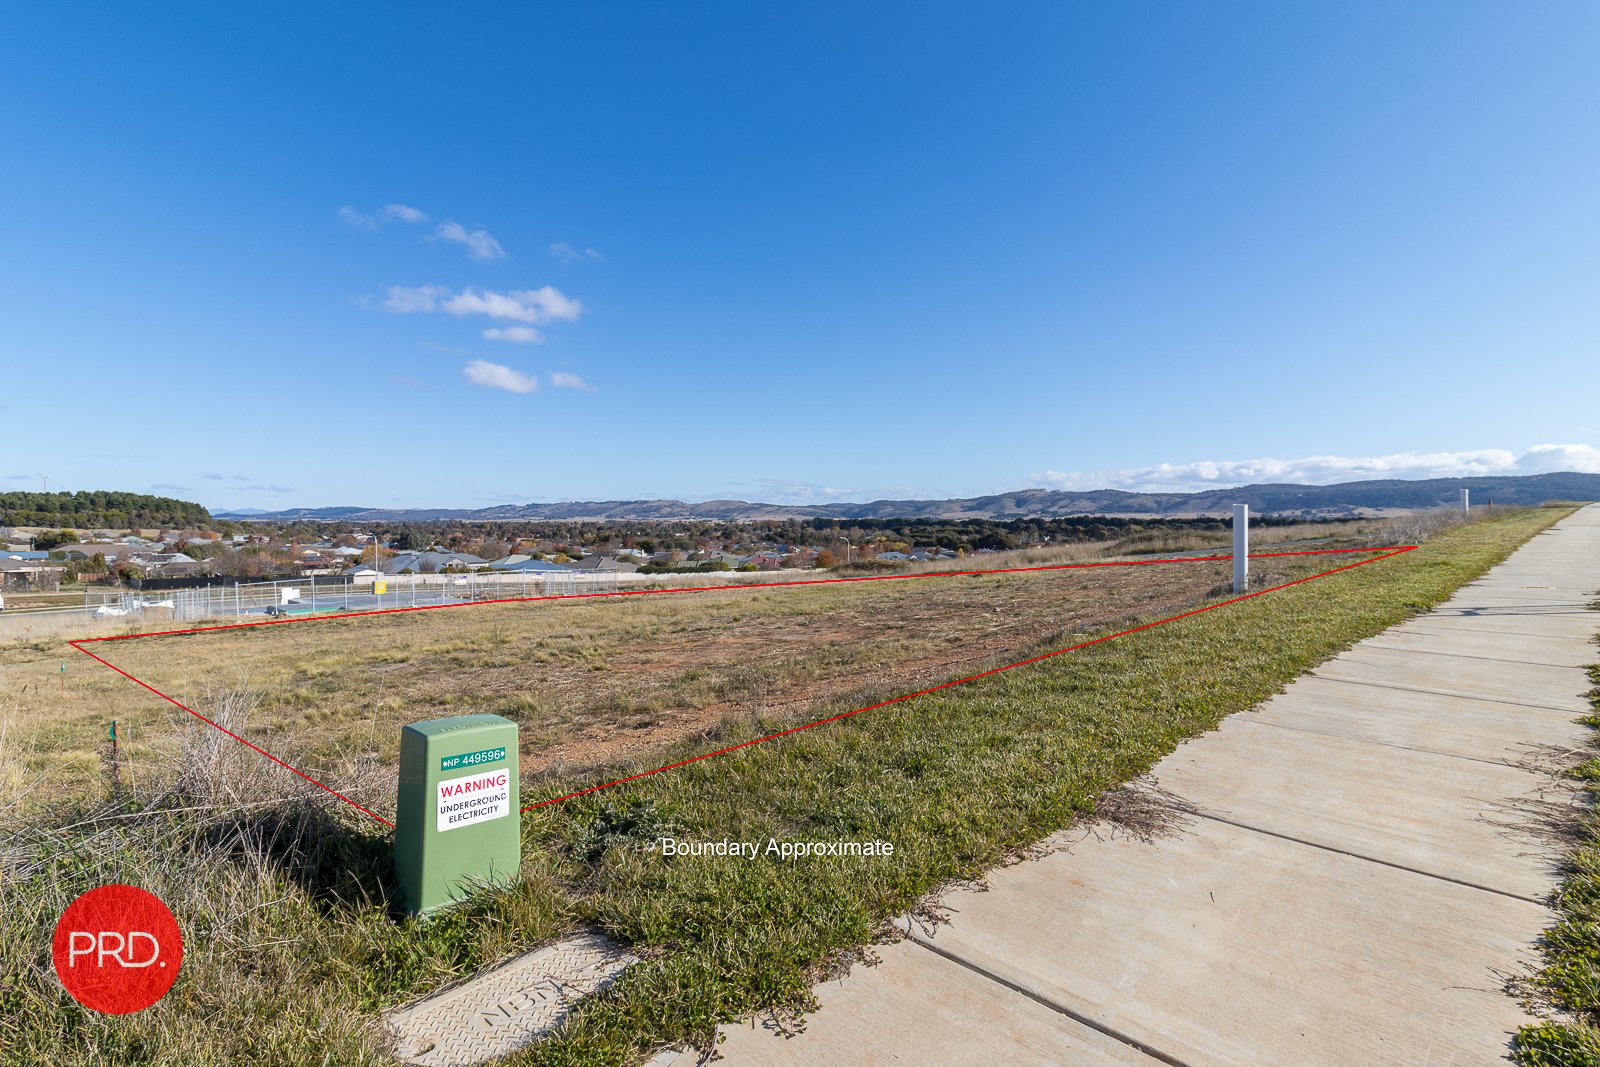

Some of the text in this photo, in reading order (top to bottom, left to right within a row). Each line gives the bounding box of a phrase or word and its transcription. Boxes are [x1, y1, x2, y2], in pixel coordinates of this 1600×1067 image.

[447, 749, 501, 767] NP 449596
[440, 774, 507, 798] WARNING
[440, 792, 507, 814] UNDERGROUND
[448, 805, 499, 823] ELECTRICITY
[473, 979, 562, 1027] NBN
